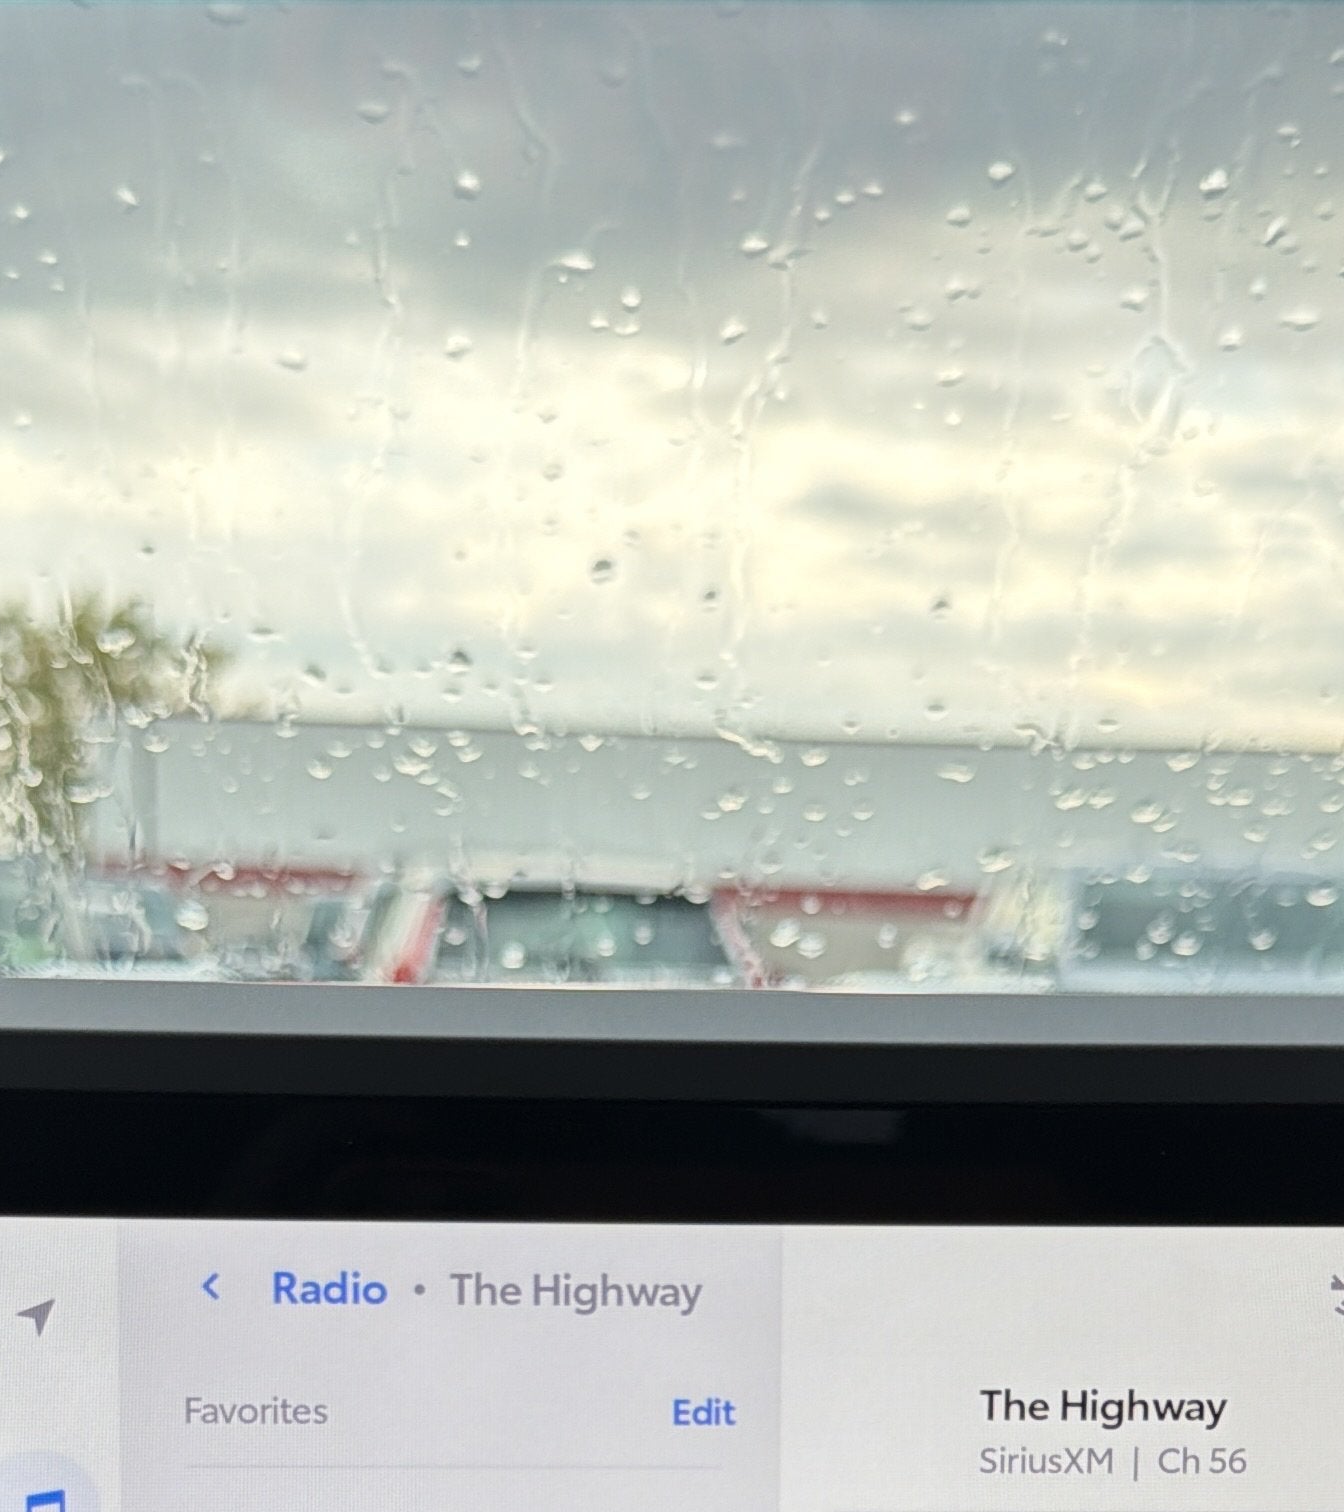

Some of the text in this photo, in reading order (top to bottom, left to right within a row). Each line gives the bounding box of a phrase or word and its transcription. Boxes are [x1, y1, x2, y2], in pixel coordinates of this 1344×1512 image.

[273, 1269, 703, 1315] Radio The Highway
[185, 1393, 328, 1425] Favorites
[673, 1396, 736, 1425] Edit
[981, 1388, 1227, 1428] The Highway
[980, 1446, 1113, 1474] SiriusXM
[1158, 1446, 1200, 1474] Ch
[1209, 1447, 1247, 1474] 56
